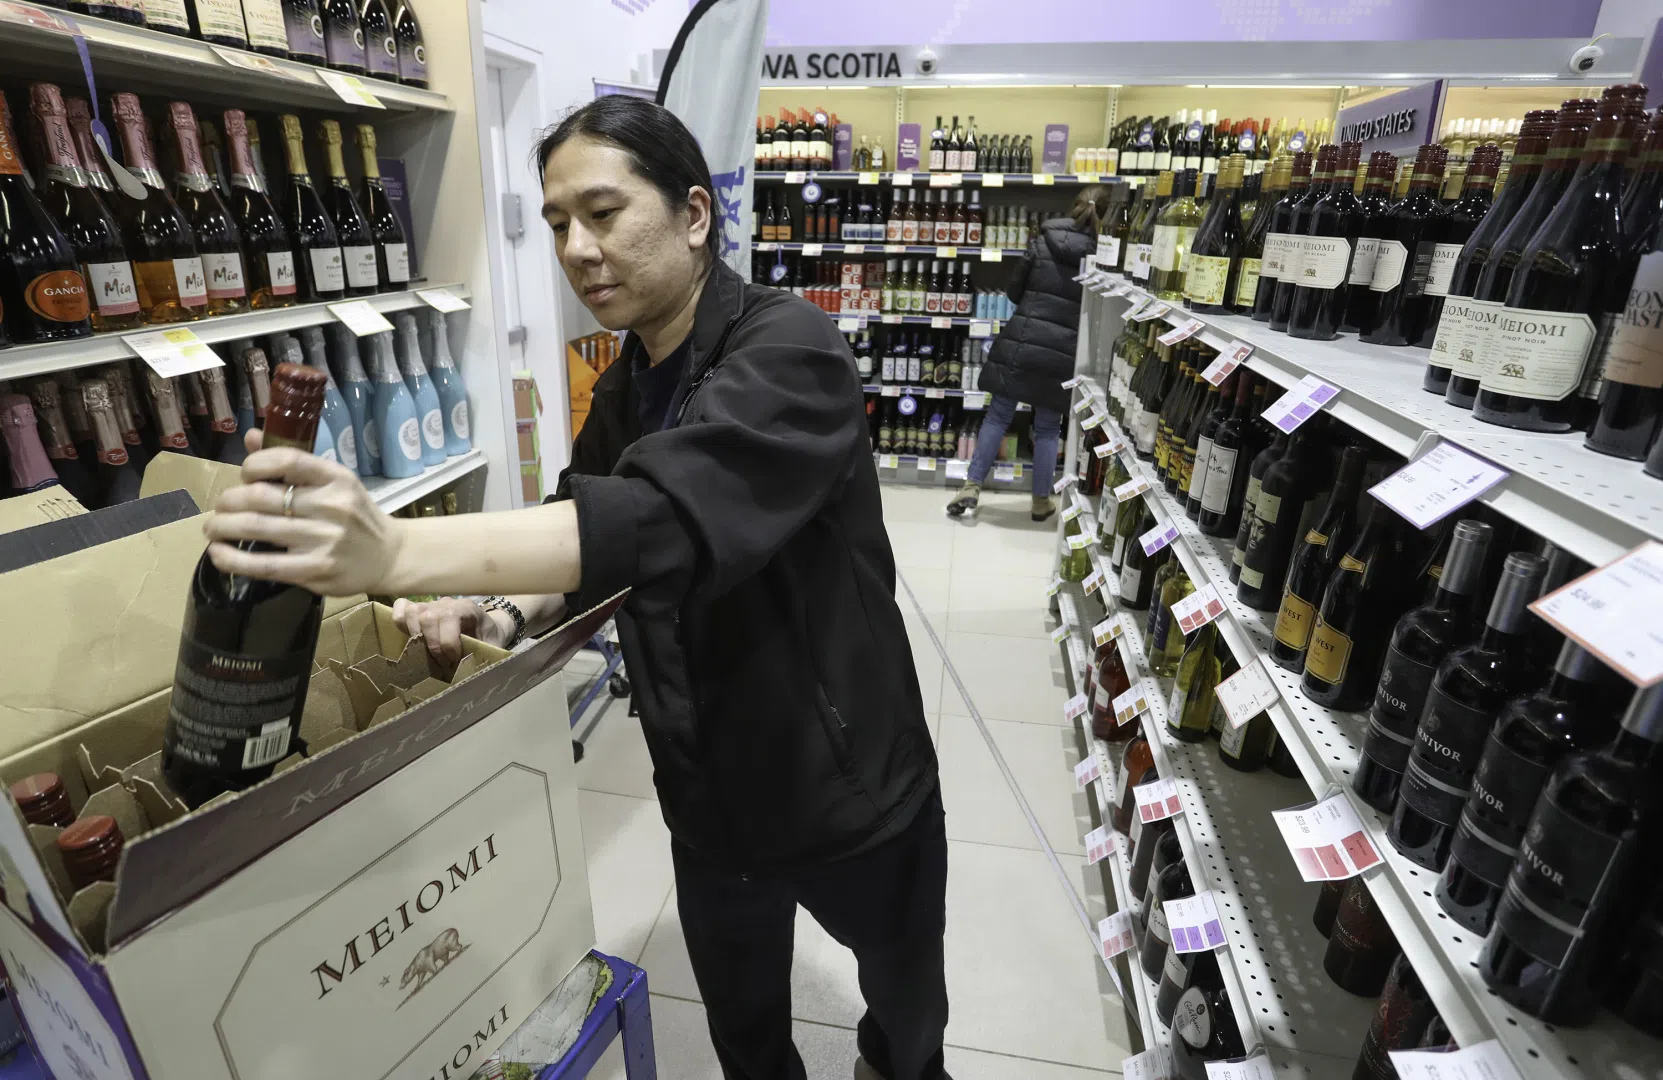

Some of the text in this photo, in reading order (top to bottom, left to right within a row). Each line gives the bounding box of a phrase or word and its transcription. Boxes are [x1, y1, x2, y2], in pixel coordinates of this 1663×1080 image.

[807, 53, 901, 78] SCOTIA
[1341, 108, 1414, 142] UNITED STATES
[44, 287, 85, 297] GANCIA
[1502, 334, 1521, 342] PINOT
[1283, 606, 1302, 620] WEST
[1316, 637, 1336, 653] WEST
[211, 654, 262, 671] MEIOMI
[281, 672, 520, 820] MEIOMI
[310, 833, 499, 1000] MEIOMI
[7, 948, 111, 1069] MEIOMI
[430, 1004, 510, 1080] IOMI
